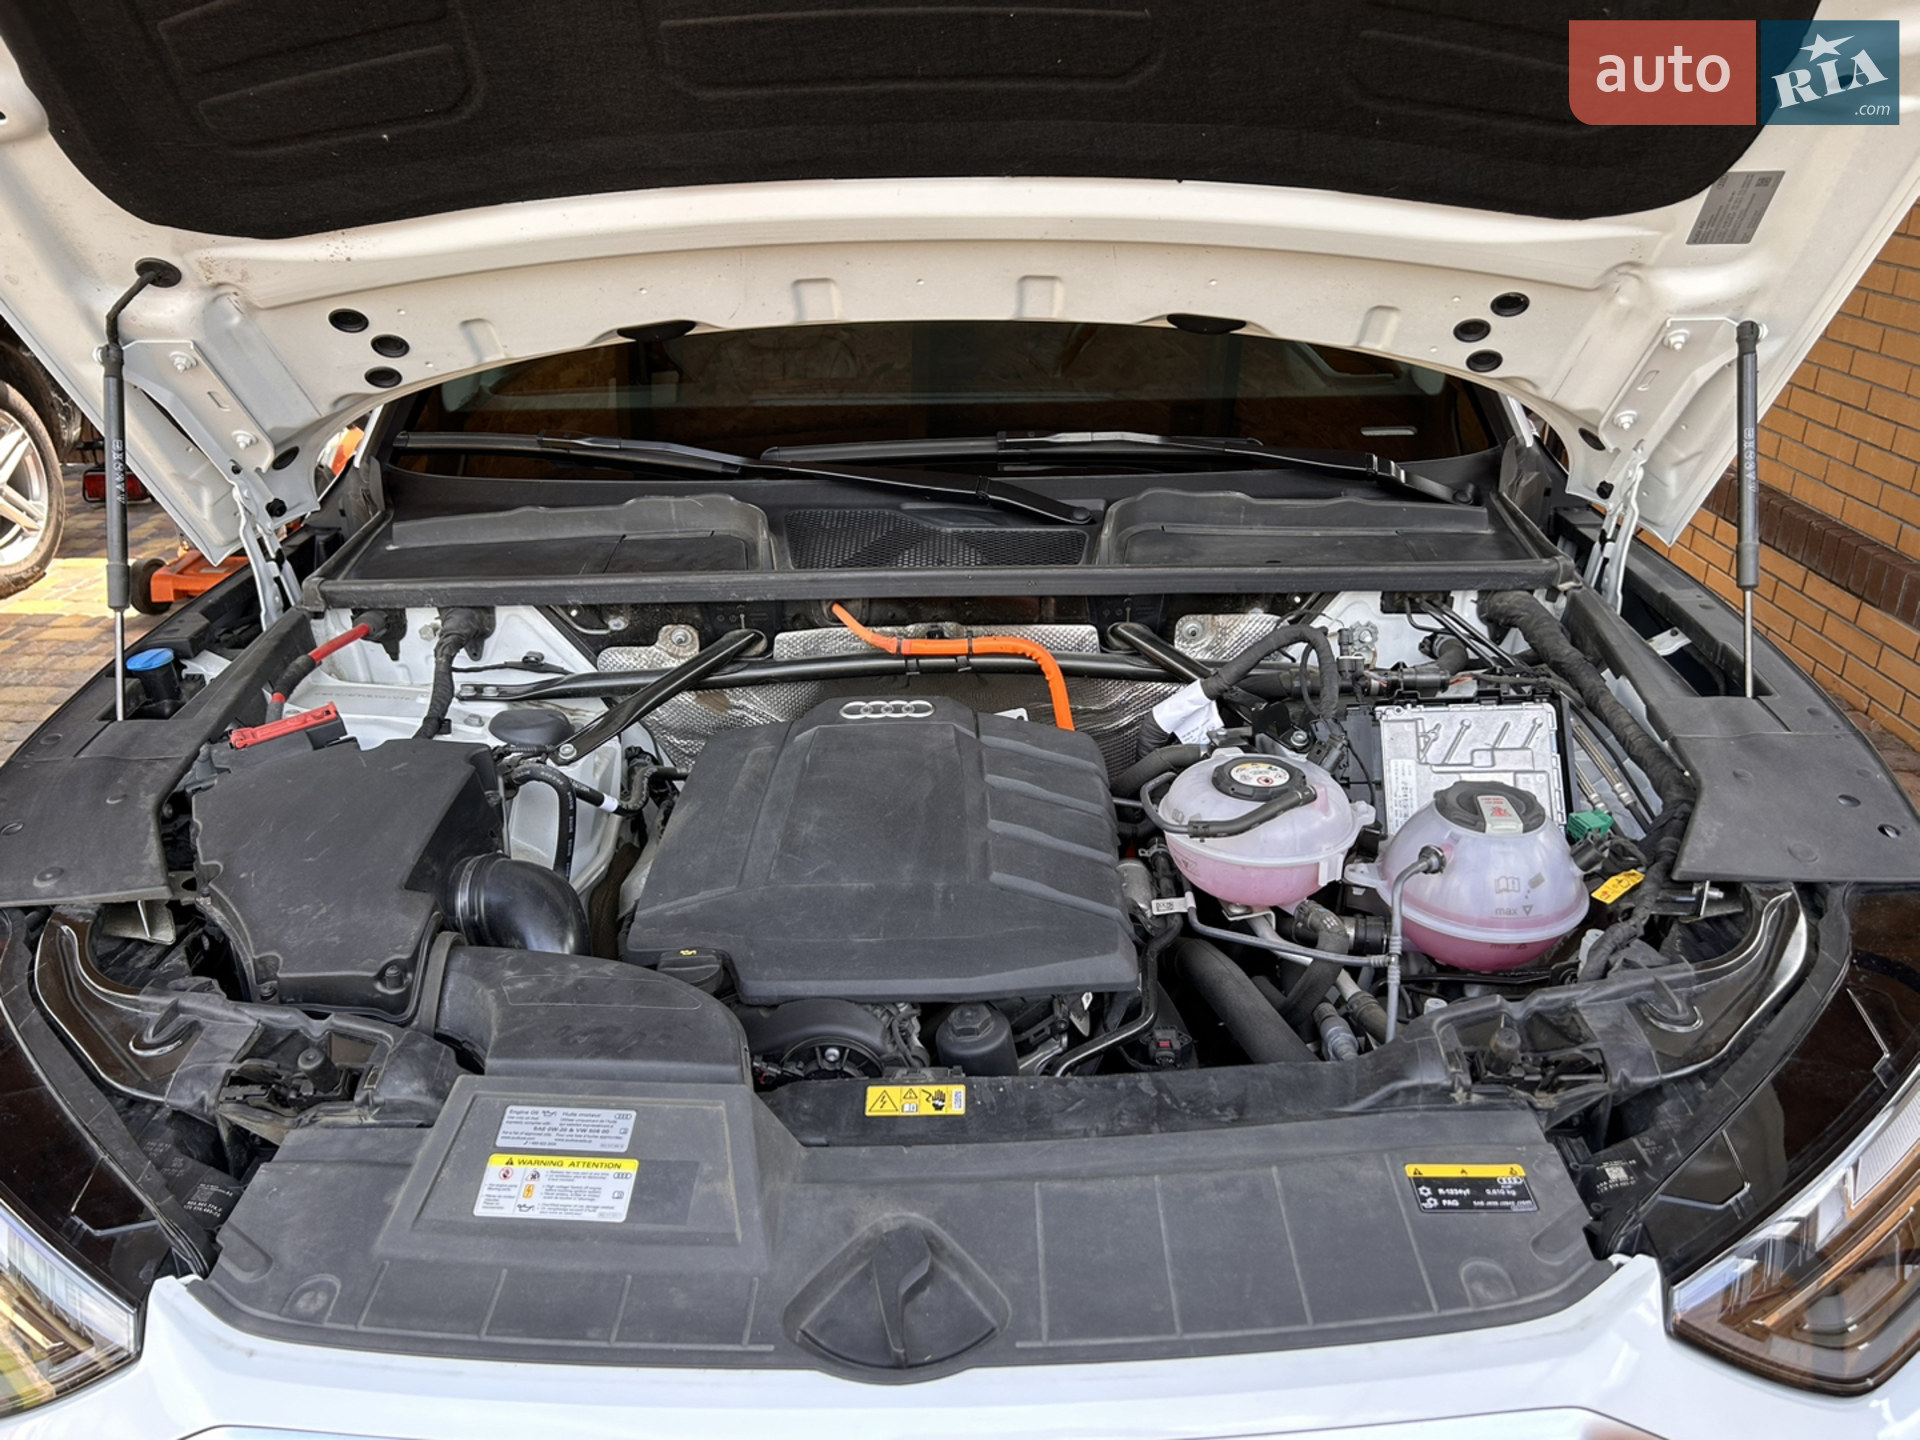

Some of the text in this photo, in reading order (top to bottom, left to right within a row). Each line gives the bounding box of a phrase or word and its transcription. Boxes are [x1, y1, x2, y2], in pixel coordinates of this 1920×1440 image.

[1495, 907, 1518, 916] max
[517, 1160, 622, 1170] WARNING ATTENTION
